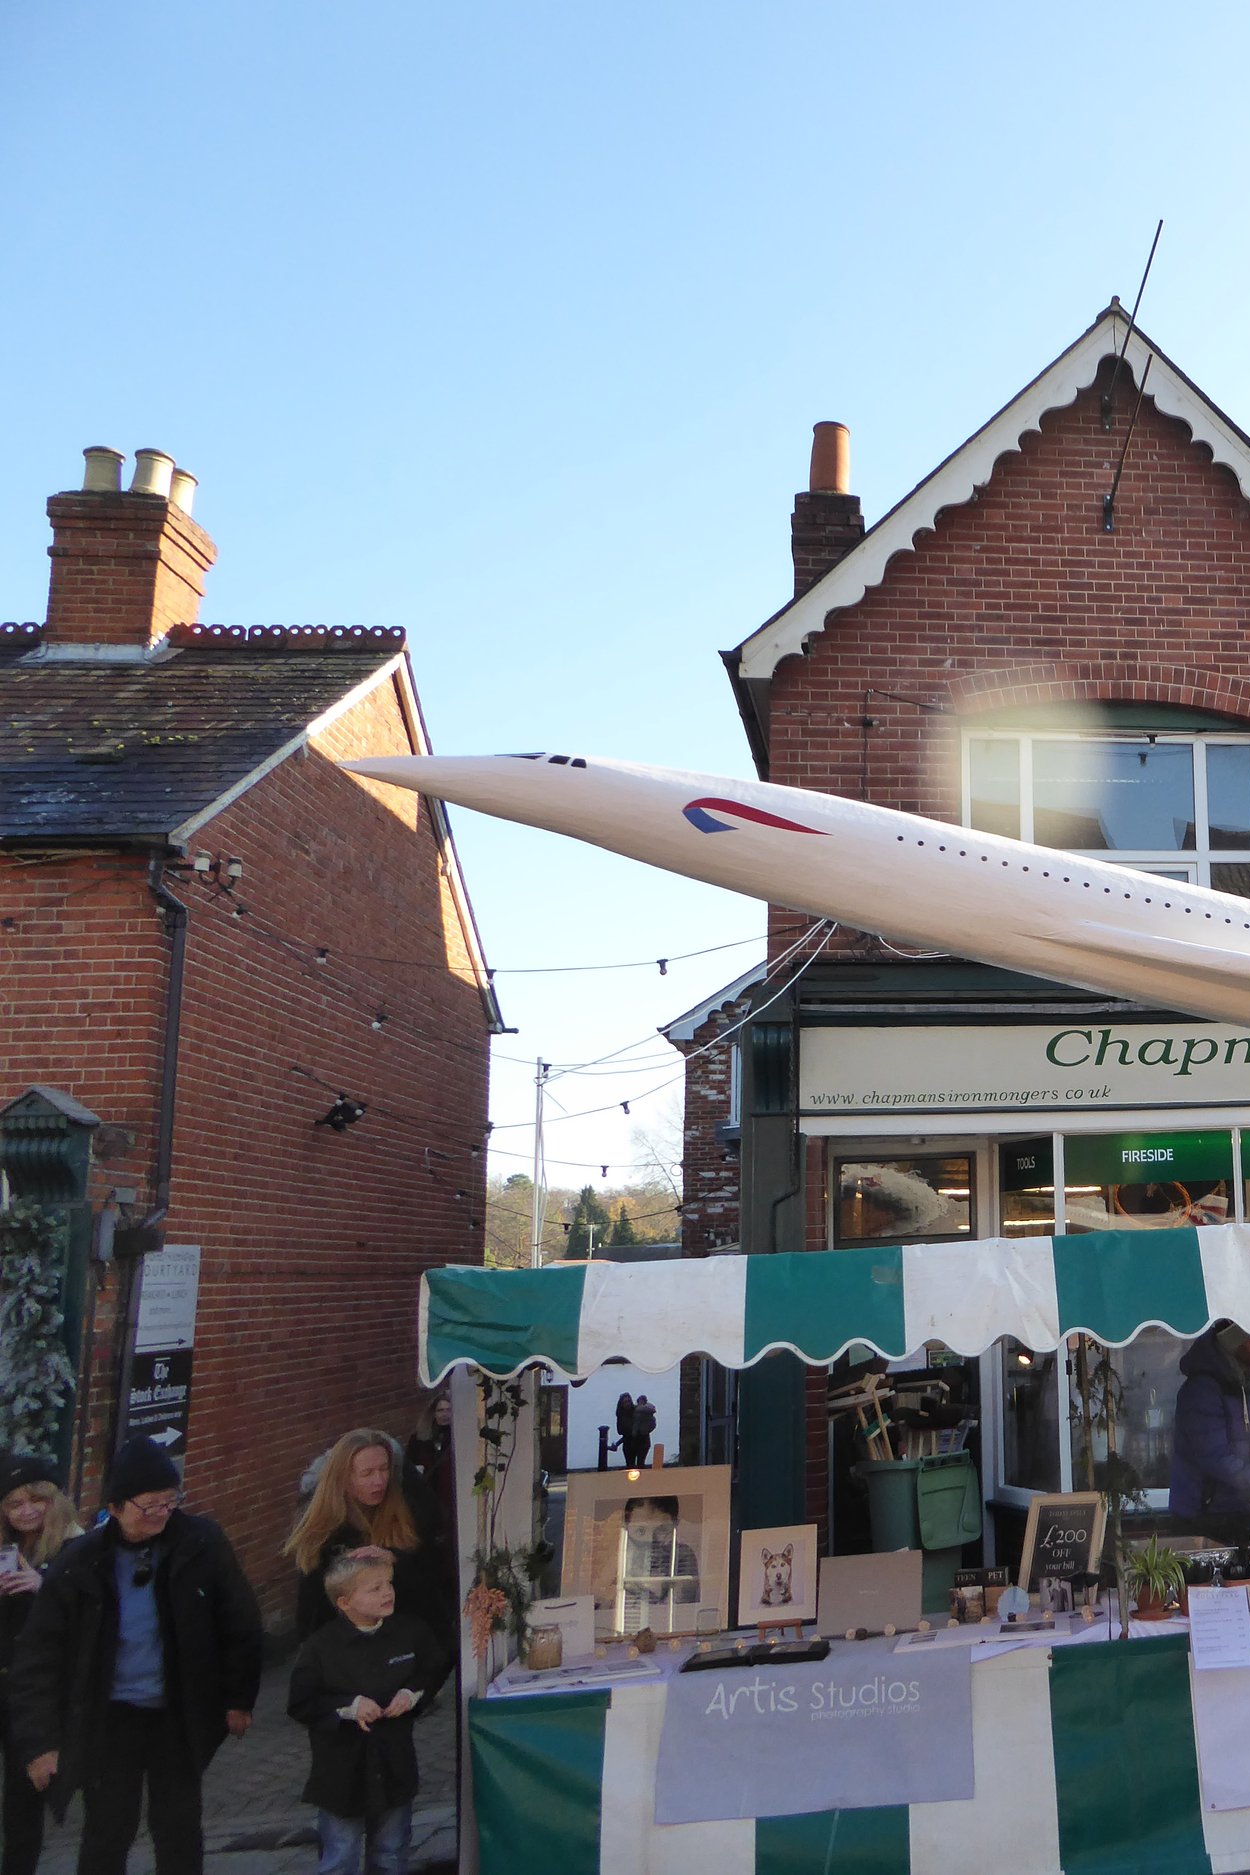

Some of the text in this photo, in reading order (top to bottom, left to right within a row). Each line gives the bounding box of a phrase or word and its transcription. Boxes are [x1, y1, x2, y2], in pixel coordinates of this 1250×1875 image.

[1016, 1155, 1036, 1171] TOOLS
[1121, 1148, 1174, 1163] FIRESIDE
[143, 1263, 198, 1277] OURTYARD
[1039, 1524, 1087, 1548] £200
[1052, 1548, 1072, 1558] OFF
[1045, 1560, 1076, 1571] your bill
[987, 1571, 1003, 1580] PET
[705, 1675, 921, 1720] Artis Studios
[810, 1702, 921, 1721] photography studio
